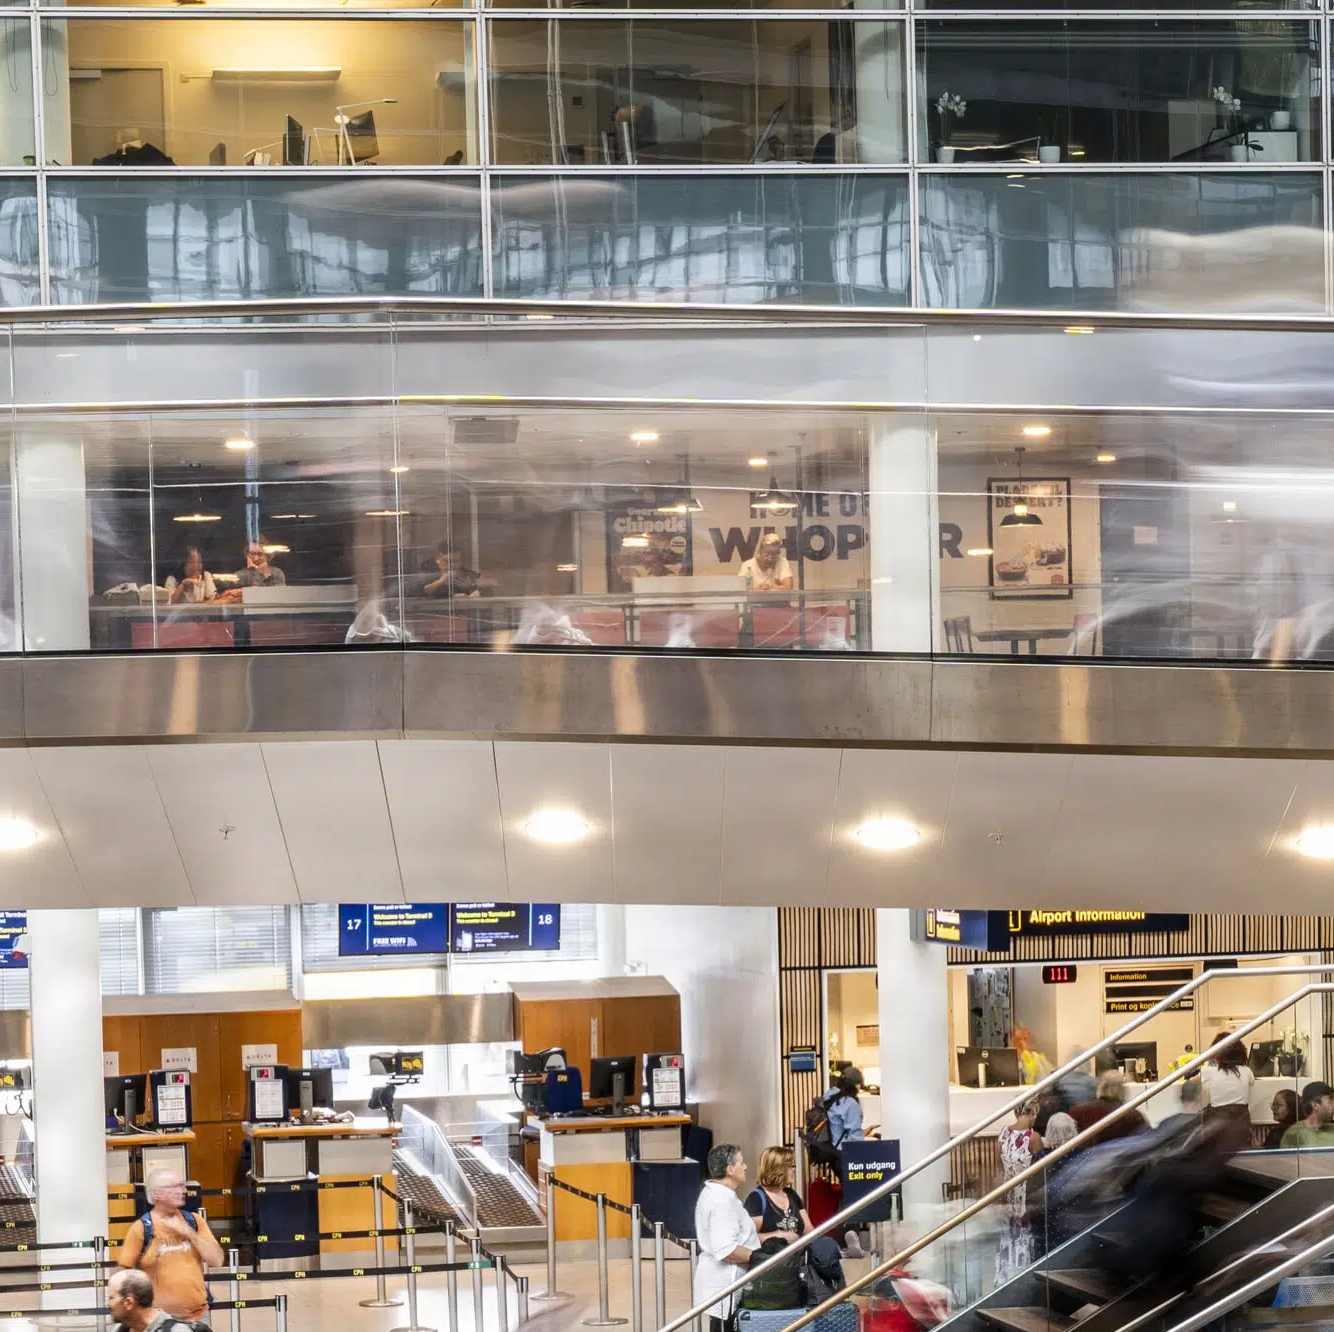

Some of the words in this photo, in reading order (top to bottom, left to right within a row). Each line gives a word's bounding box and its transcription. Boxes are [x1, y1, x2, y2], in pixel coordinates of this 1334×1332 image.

[839, 489, 870, 517] O
[708, 524, 964, 563] WHOPR
[539, 914, 552, 924] 18
[1029, 911, 1071, 926] Airport
[1075, 911, 1145, 922] Information
[347, 919, 361, 930] 17
[1050, 967, 1068, 980] 111
[1110, 973, 1147, 981] Information
[1129, 1004, 1138, 1012] og
[848, 1162, 864, 1170] Kun
[866, 1161, 896, 1170] udgang
[848, 1172, 864, 1180] Exit
[866, 1172, 883, 1181] only
